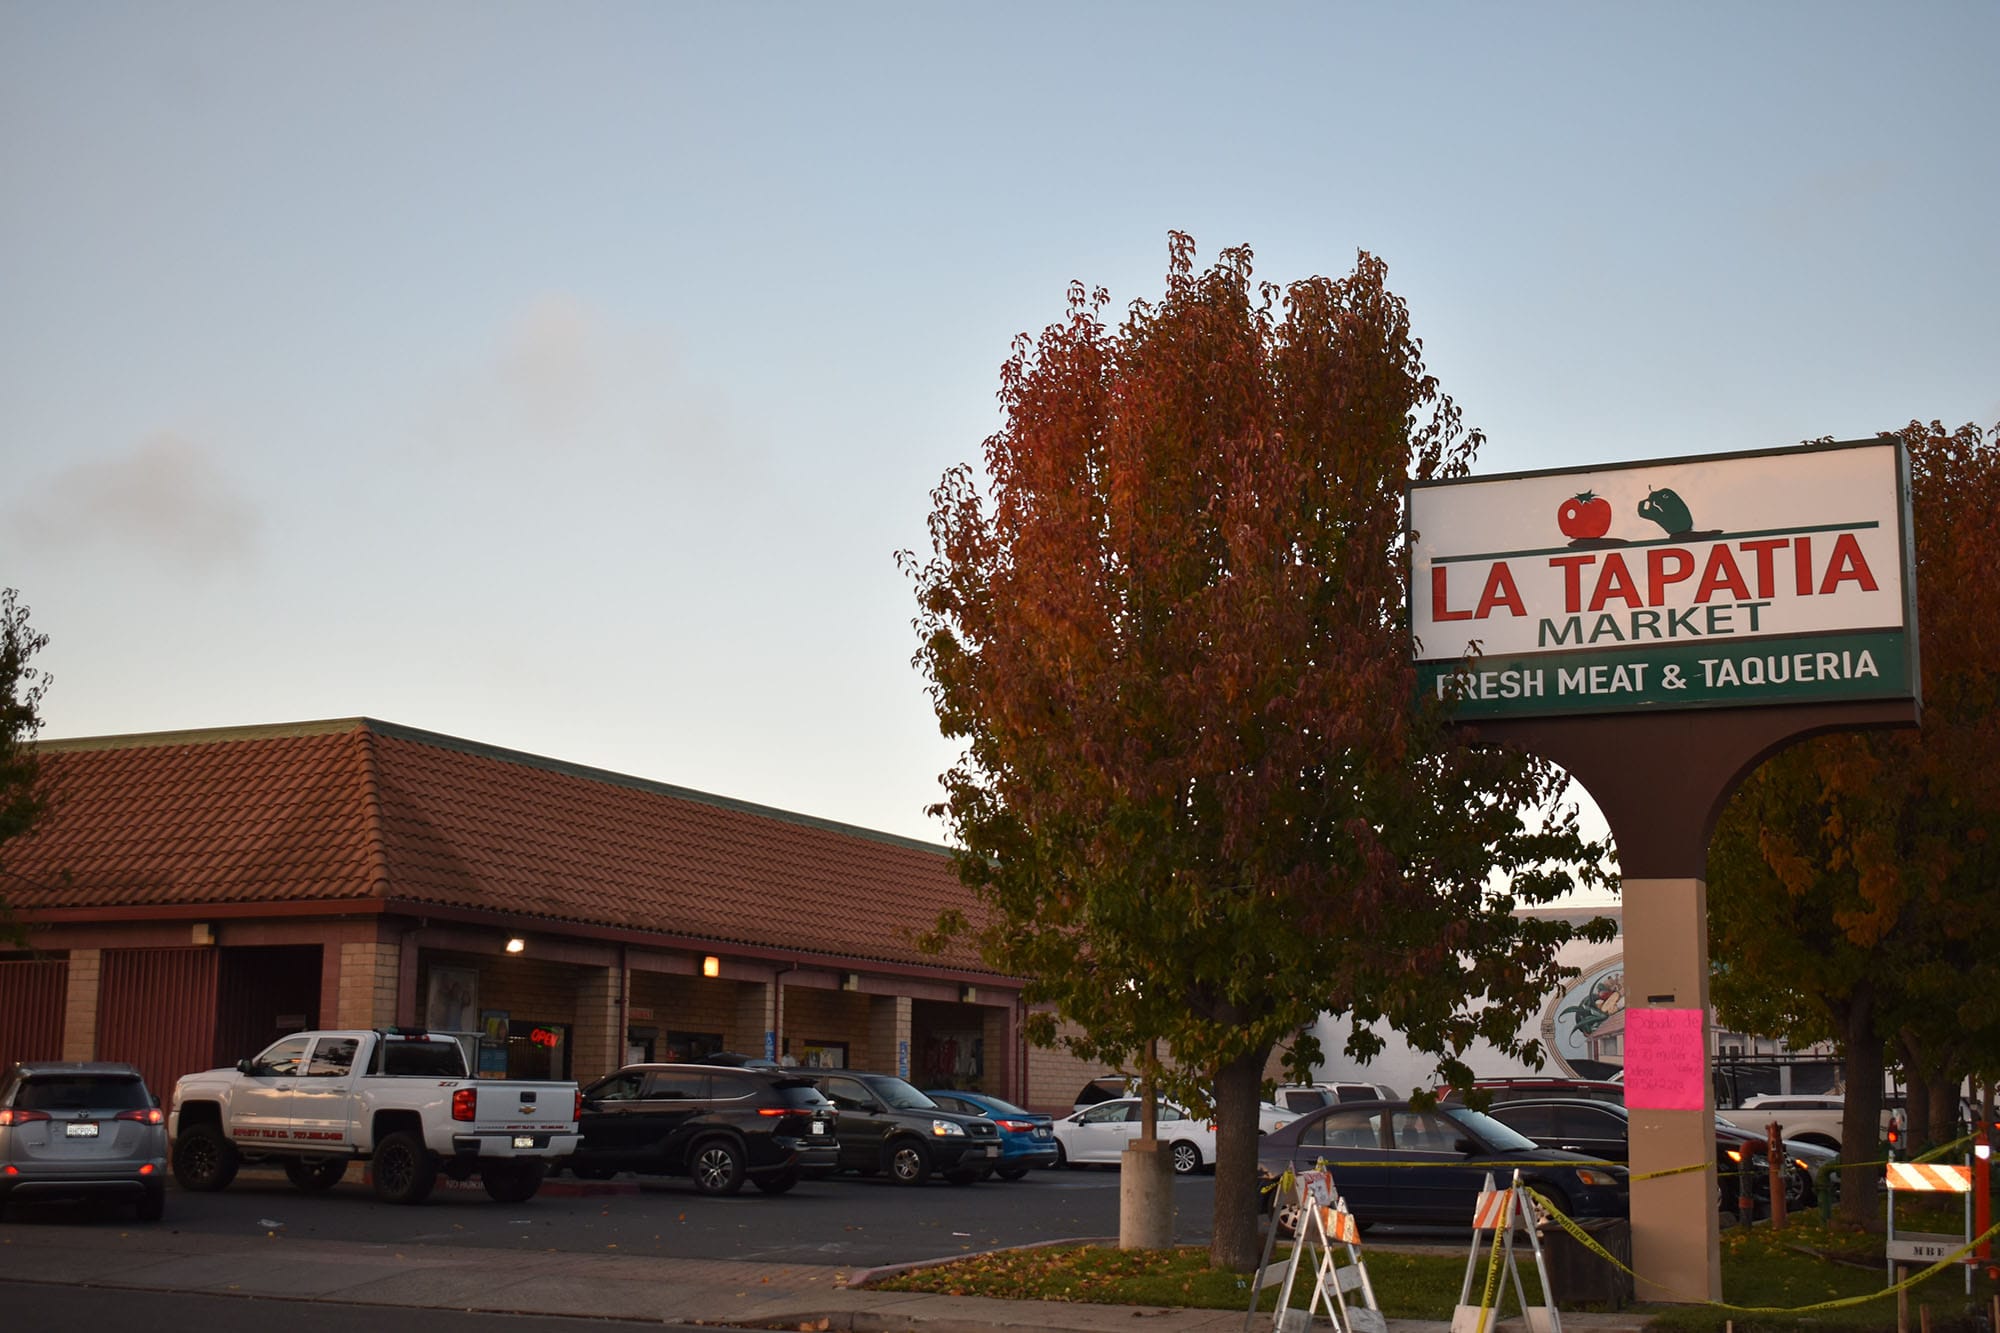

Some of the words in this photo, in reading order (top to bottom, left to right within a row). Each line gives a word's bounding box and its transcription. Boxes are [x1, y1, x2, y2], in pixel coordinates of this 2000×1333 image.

[1432, 561, 1528, 623] LA
[1549, 533, 1880, 614] TAPATIA
[1538, 601, 1772, 648] MARKET
[1557, 663, 1648, 693] MEAT
[1661, 664, 1687, 690] &
[1698, 650, 1880, 688] TAQUERIA
[531, 1028, 559, 1048] OPEN
[1913, 1246, 1945, 1257] MBE
